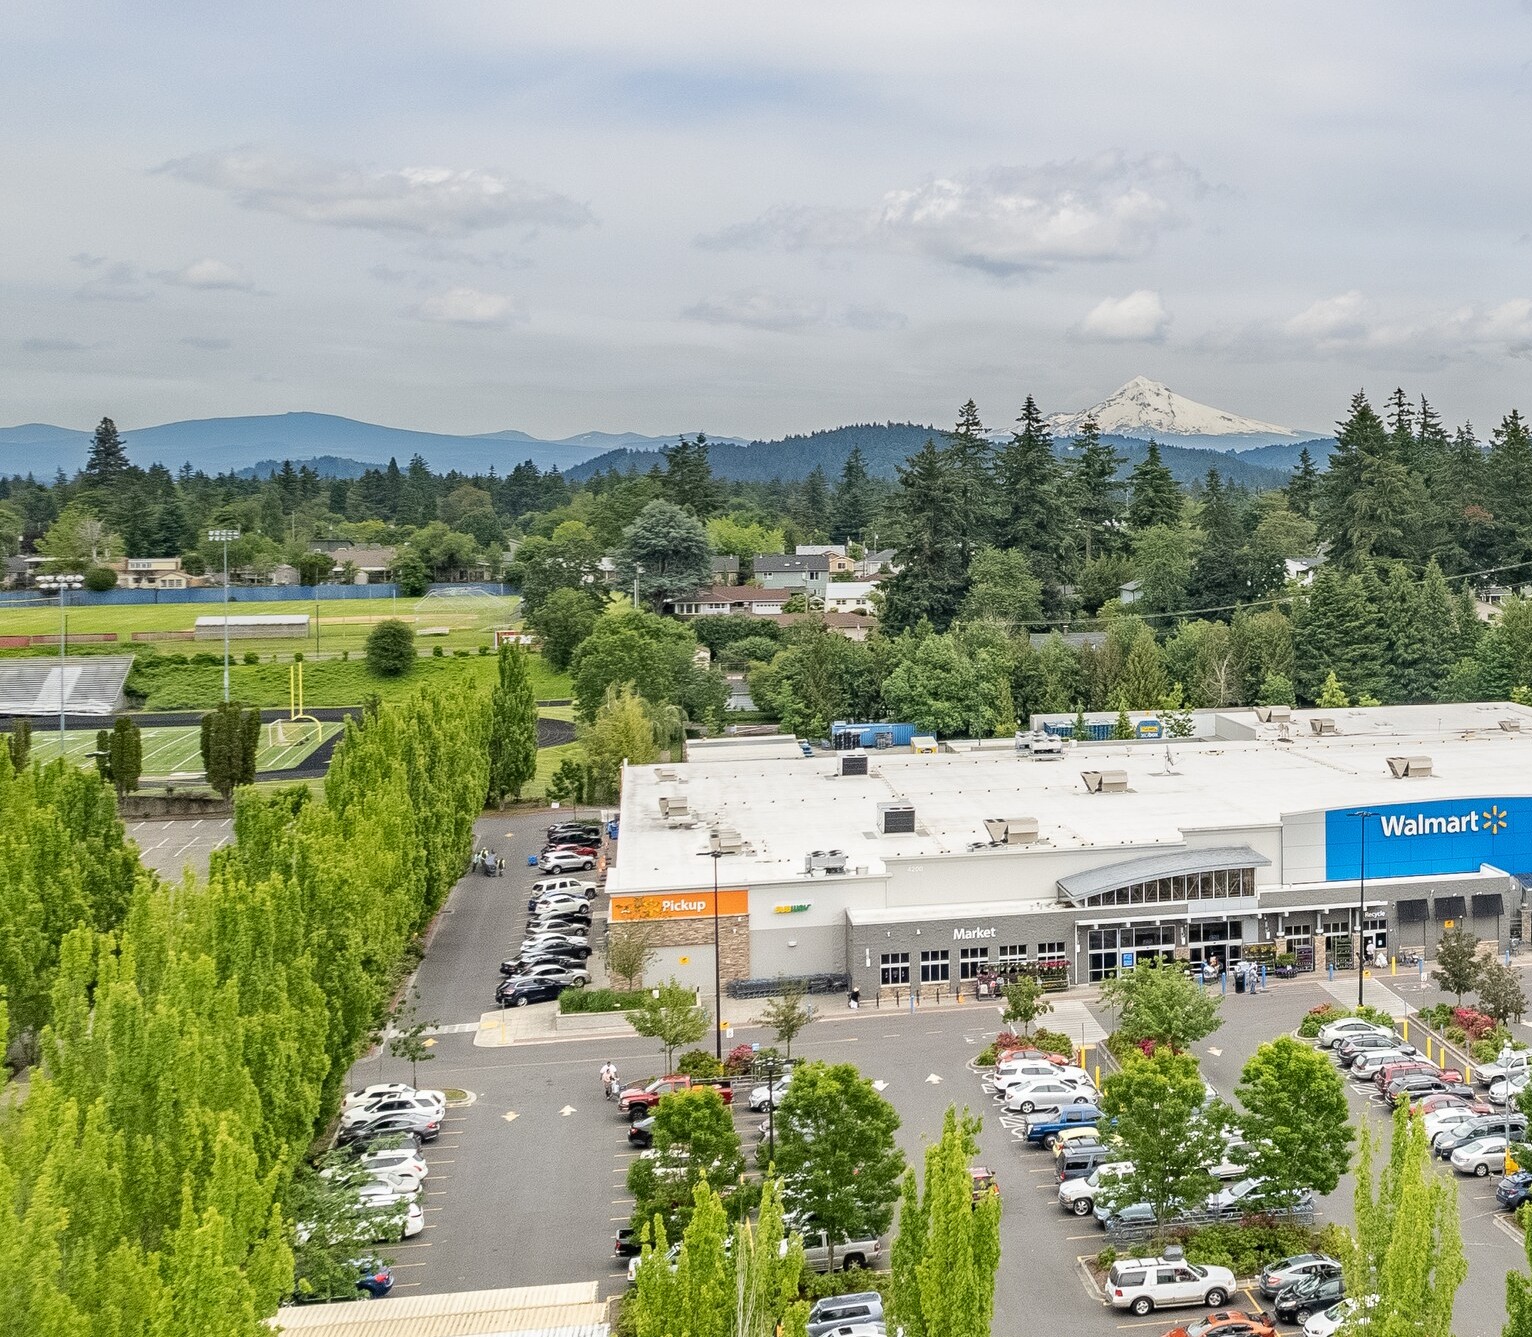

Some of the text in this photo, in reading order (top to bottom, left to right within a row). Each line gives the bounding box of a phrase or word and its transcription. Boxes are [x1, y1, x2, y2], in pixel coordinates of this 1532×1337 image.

[1381, 810, 1479, 837] Walmart
[662, 899, 706, 911] Pickup
[953, 926, 996, 940] Market
